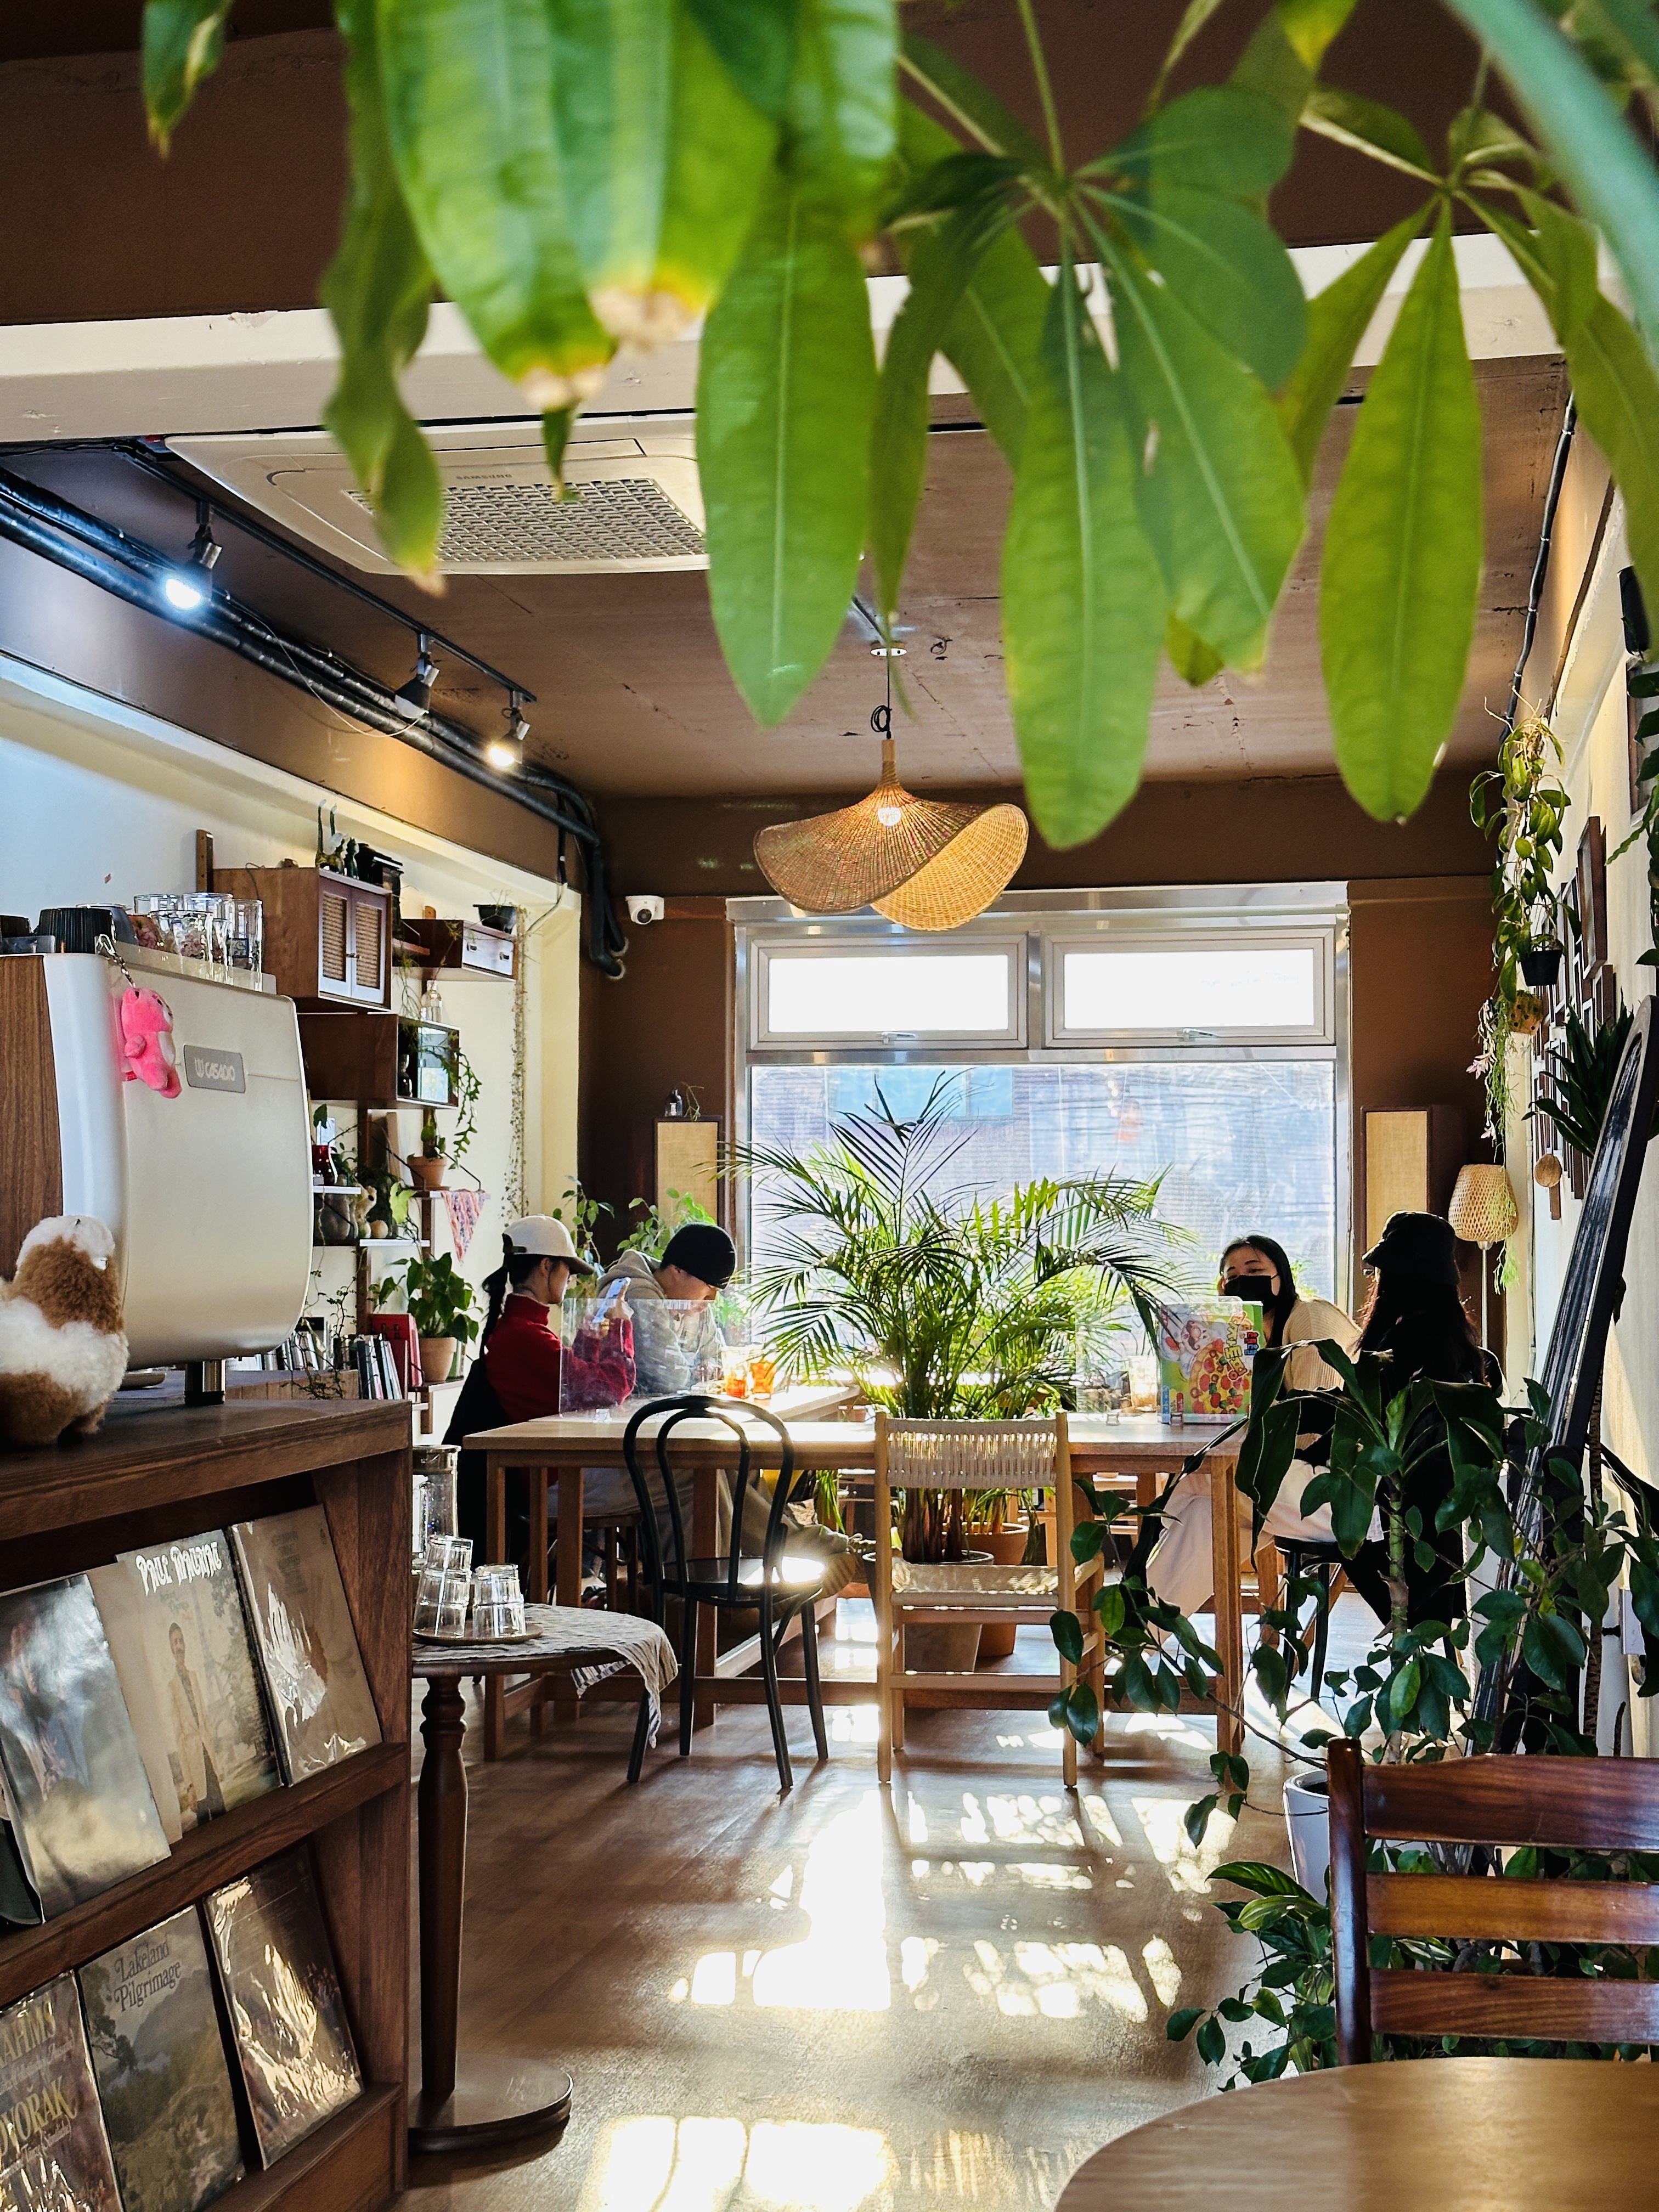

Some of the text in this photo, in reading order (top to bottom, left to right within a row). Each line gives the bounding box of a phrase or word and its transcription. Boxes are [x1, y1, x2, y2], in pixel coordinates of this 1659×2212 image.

[114, 1932, 170, 1983] Lakeland
[114, 1961, 181, 2012] Pilgrimage
[0, 2000, 56, 2068] AHMS
